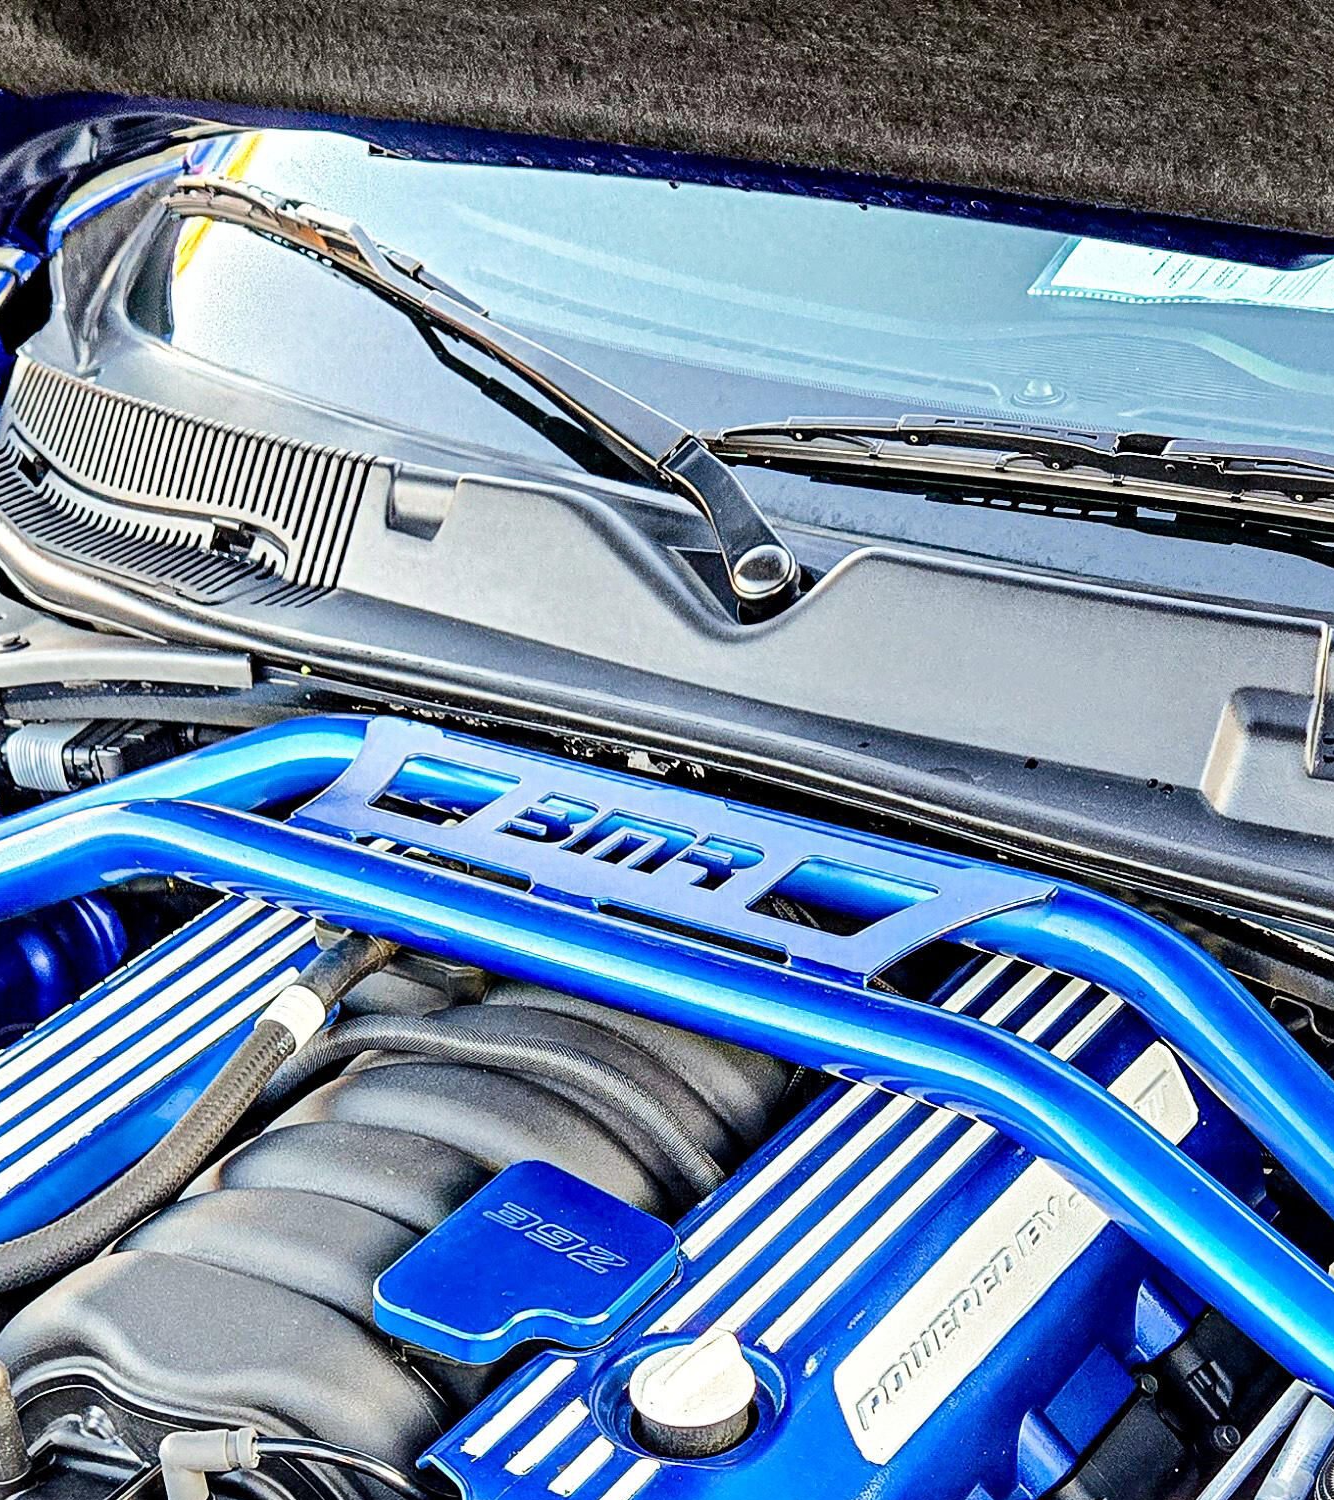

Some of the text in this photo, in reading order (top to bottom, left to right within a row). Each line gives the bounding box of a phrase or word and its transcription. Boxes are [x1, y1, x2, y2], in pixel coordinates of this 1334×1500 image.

[495, 792, 767, 891] BMR
[483, 1201, 629, 1274] 392
[855, 1195, 1062, 1432] POWERED BY
